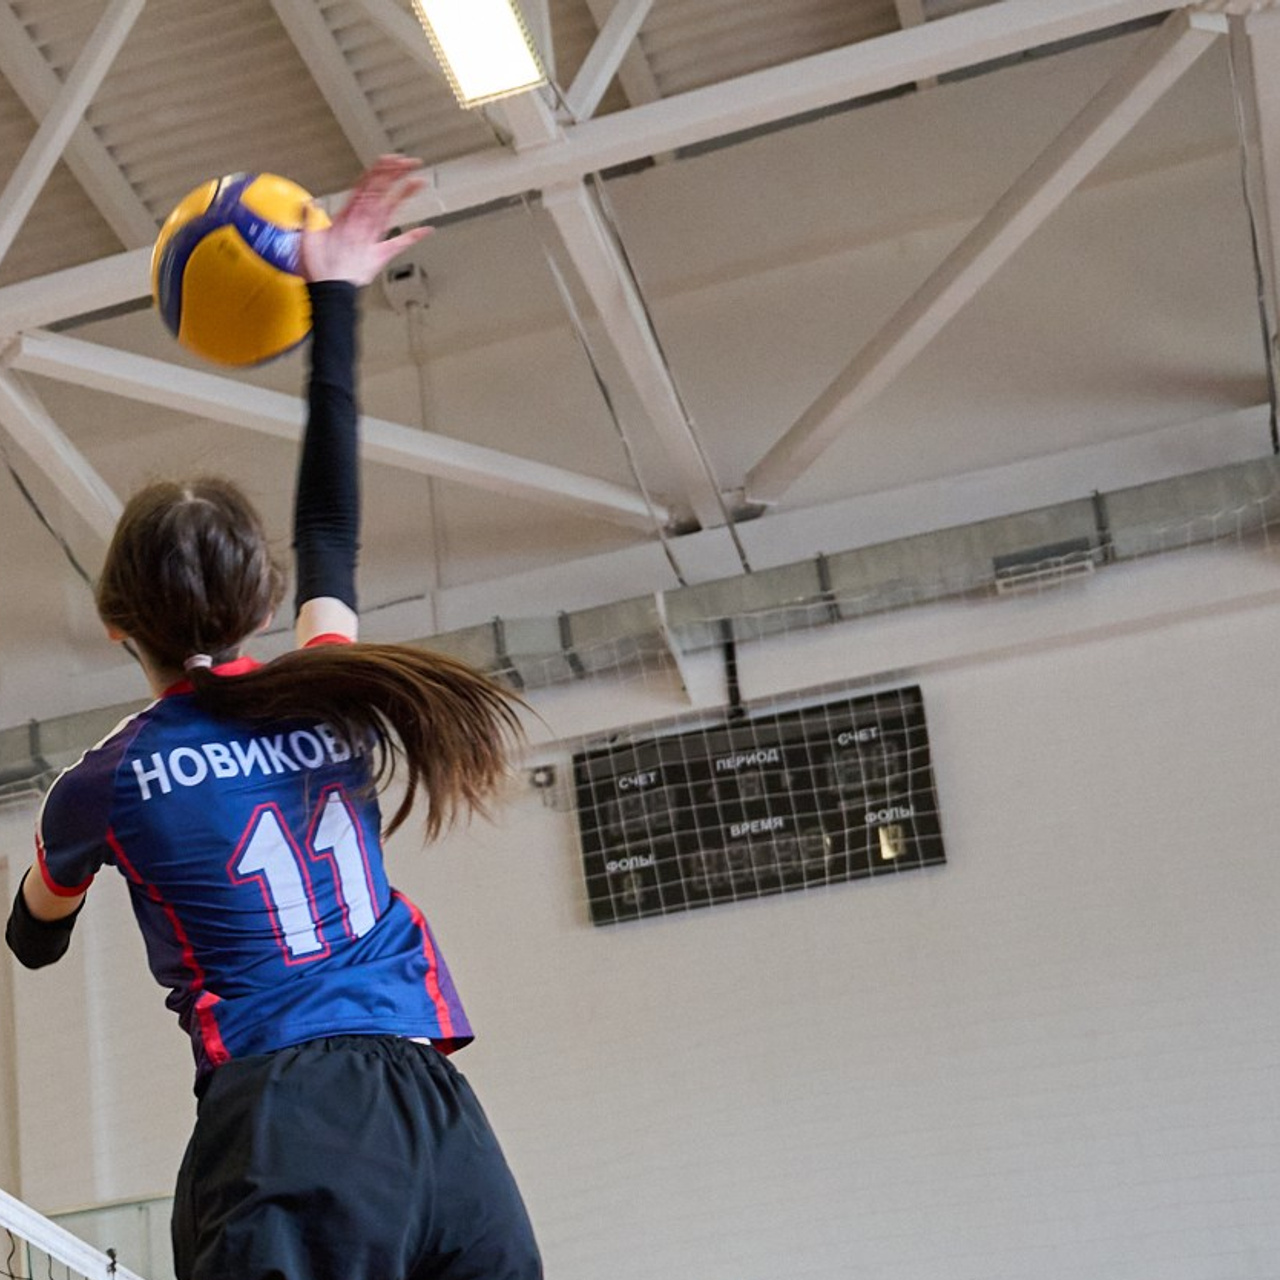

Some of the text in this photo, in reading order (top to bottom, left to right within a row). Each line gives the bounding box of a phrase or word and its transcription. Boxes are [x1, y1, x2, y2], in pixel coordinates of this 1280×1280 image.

[838, 727, 878, 746] СЧЕТ
[716, 750, 779, 771] ПЕРИОД
[618, 771, 657, 789] СЧЕТ
[864, 804, 915, 823] ФОЛЫ
[730, 816, 784, 838] ВРЕМЯ
[606, 853, 656, 872] ФОЛЫ
[226, 783, 380, 967] 11
